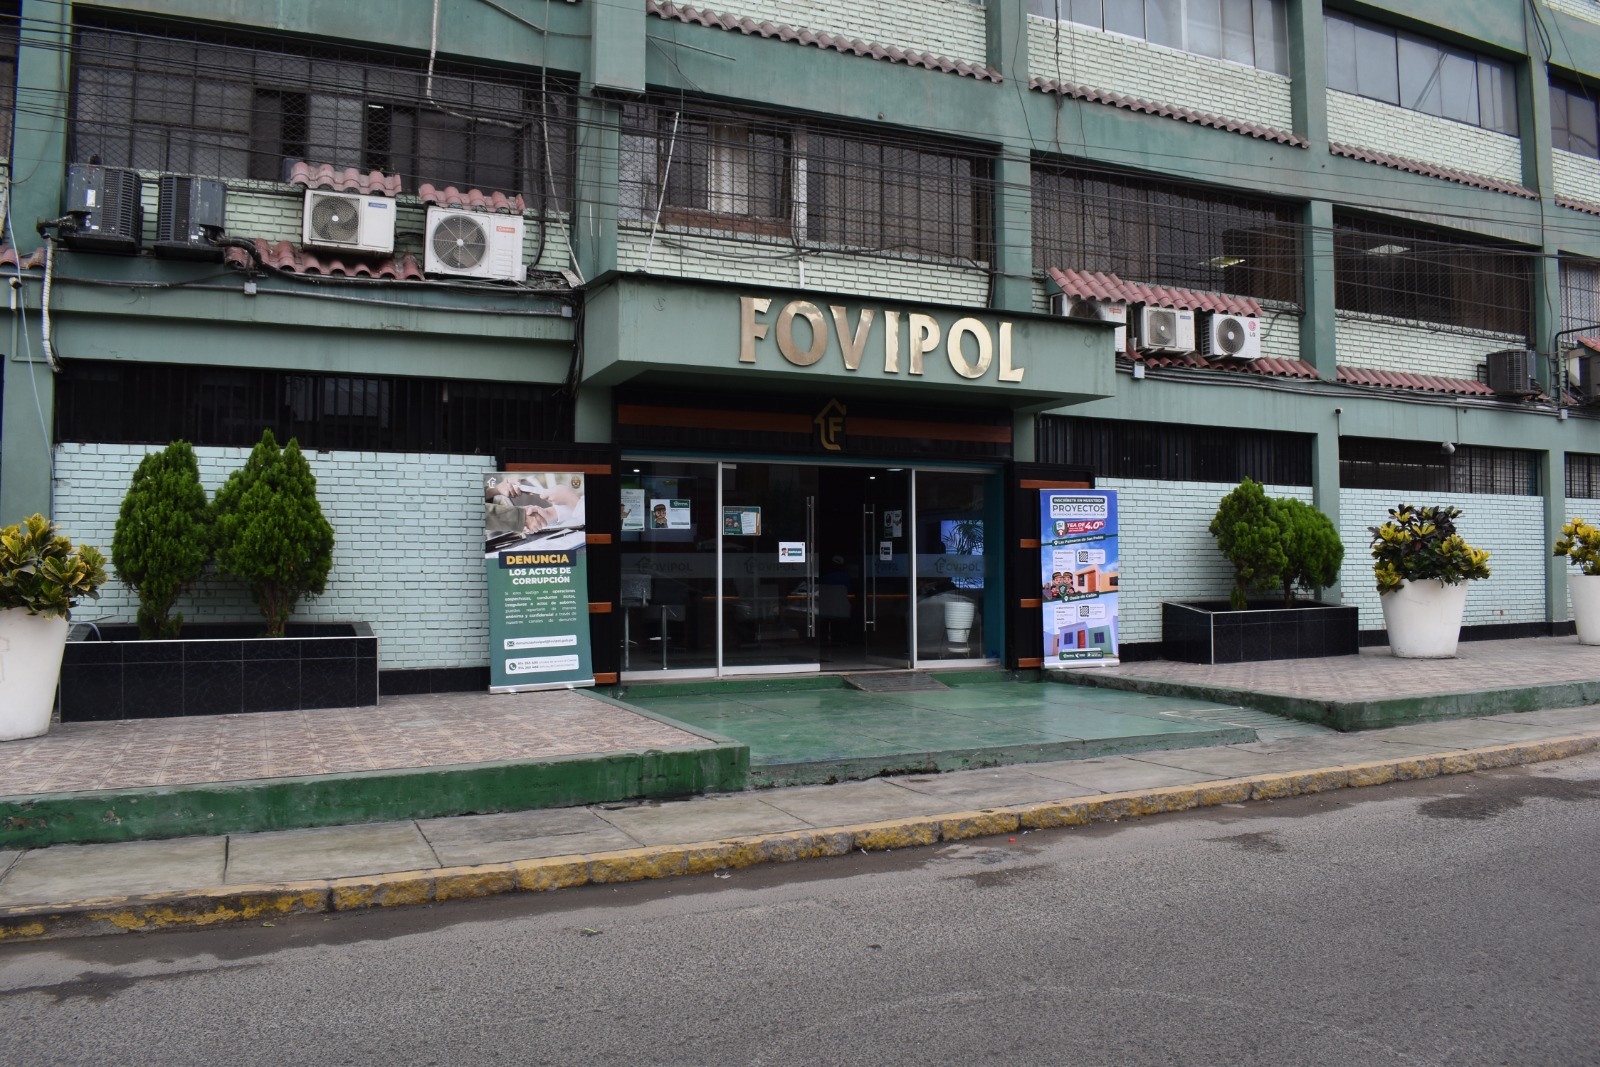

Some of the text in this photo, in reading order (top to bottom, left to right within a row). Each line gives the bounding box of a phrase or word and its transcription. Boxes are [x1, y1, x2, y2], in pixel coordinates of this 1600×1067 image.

[739, 296, 1025, 382] FOVIPOL
[506, 554, 569, 565] DENUNCIA
[512, 575, 570, 585] CORRUPCIÓN
